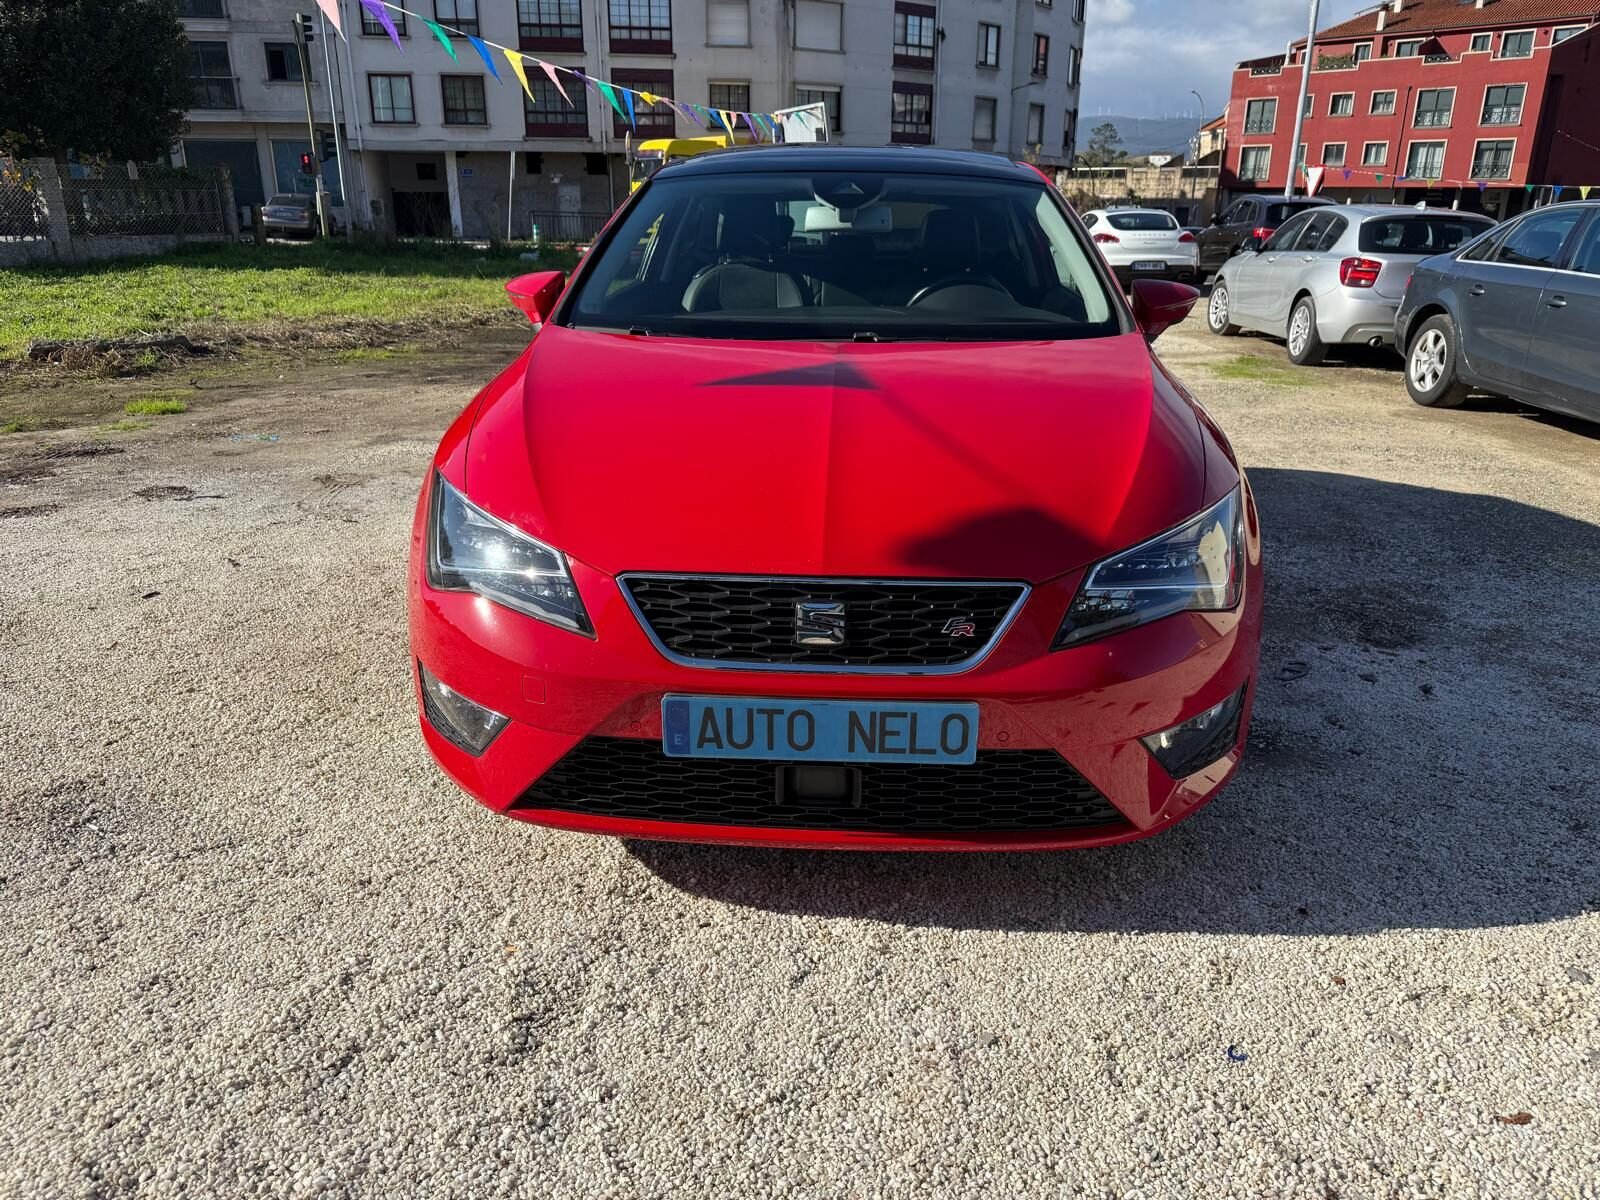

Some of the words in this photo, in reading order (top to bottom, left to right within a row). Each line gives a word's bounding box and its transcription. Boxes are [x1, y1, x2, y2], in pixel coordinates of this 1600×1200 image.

[941, 618, 975, 637] FR
[674, 734, 683, 745] E
[697, 706, 815, 752] AUTO
[848, 710, 970, 756] NELO
